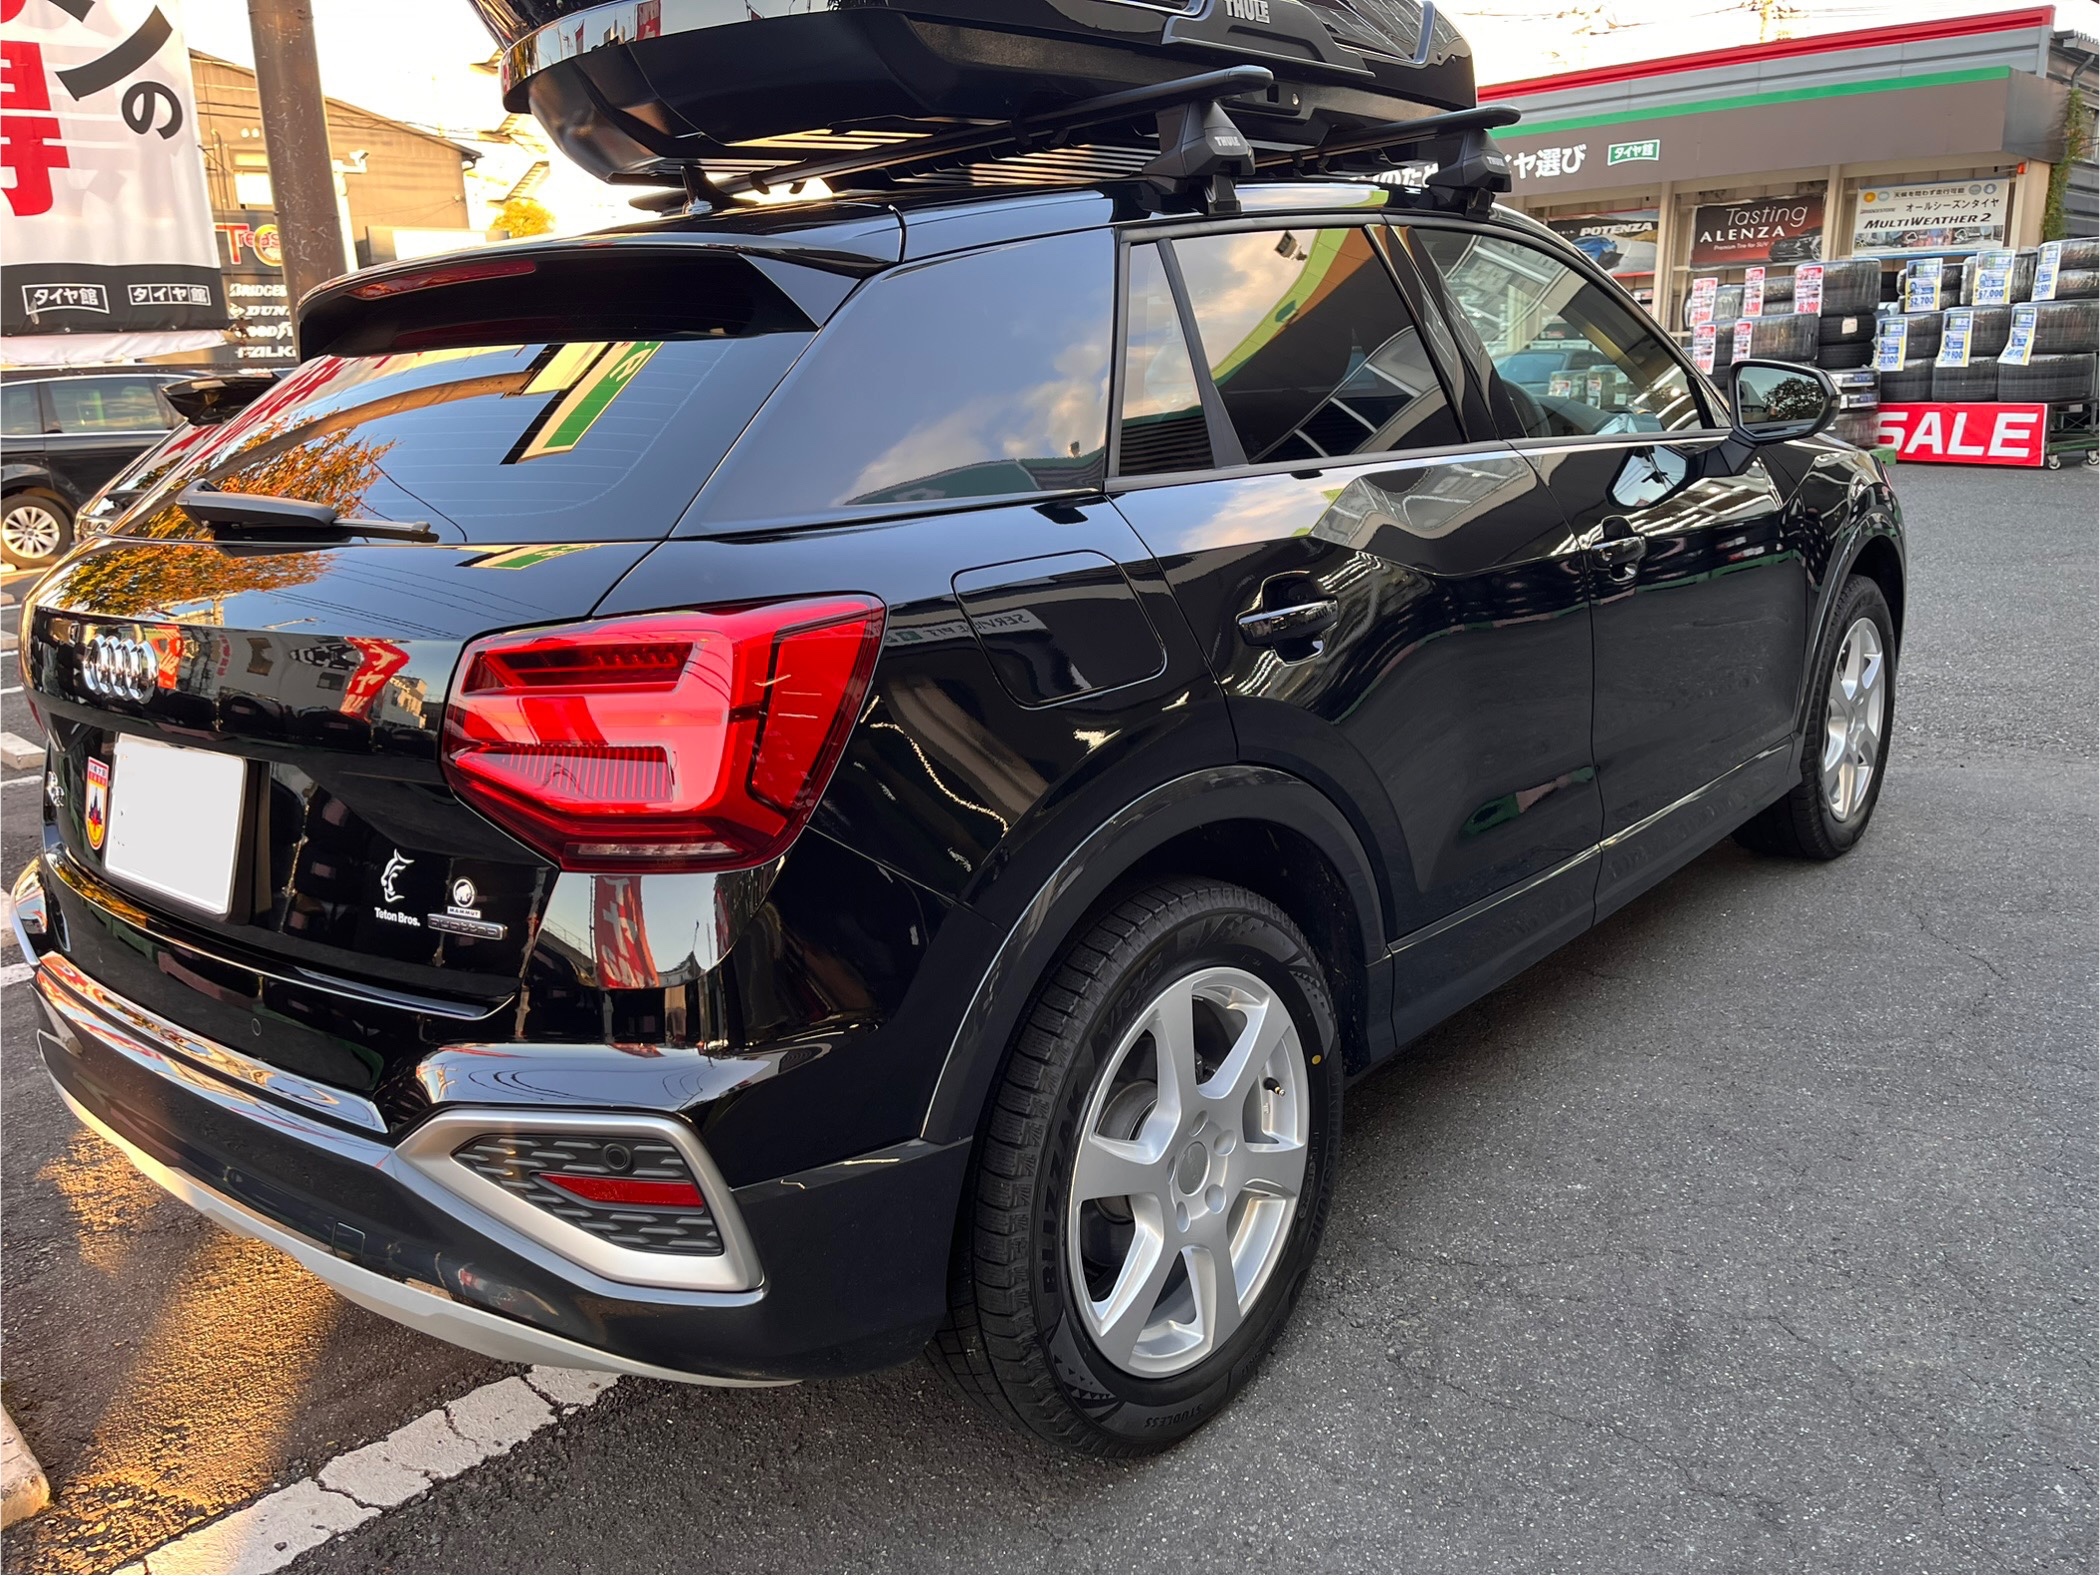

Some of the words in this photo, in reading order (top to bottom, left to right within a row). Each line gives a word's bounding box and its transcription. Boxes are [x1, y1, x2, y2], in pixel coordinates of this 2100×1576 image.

[1223, 0, 1270, 24] THULE
[1614, 143, 1654, 160] タイヤ館
[1504, 144, 1587, 179] ヤ選び
[1905, 198, 1999, 213] オールシーズンタイヤ
[1726, 206, 1808, 228] Tasting
[1980, 212, 1992, 222] 2
[1579, 222, 1653, 237] POTENZA
[1700, 225, 1786, 243] ALENZA
[34, 288, 99, 306] タイヤ館
[133, 288, 209, 303] タイヤ館
[245, 305, 290, 317] DUN
[236, 345, 297, 358] FALK
[1878, 411, 2038, 458] SALE
[374, 906, 398, 922] Teton
[398, 911, 421, 927] Bros.
[449, 907, 479, 917] MAMMUT
[1042, 1079, 1084, 1294] BLIZZAK
[1143, 1402, 1204, 1429] STUDLESS
